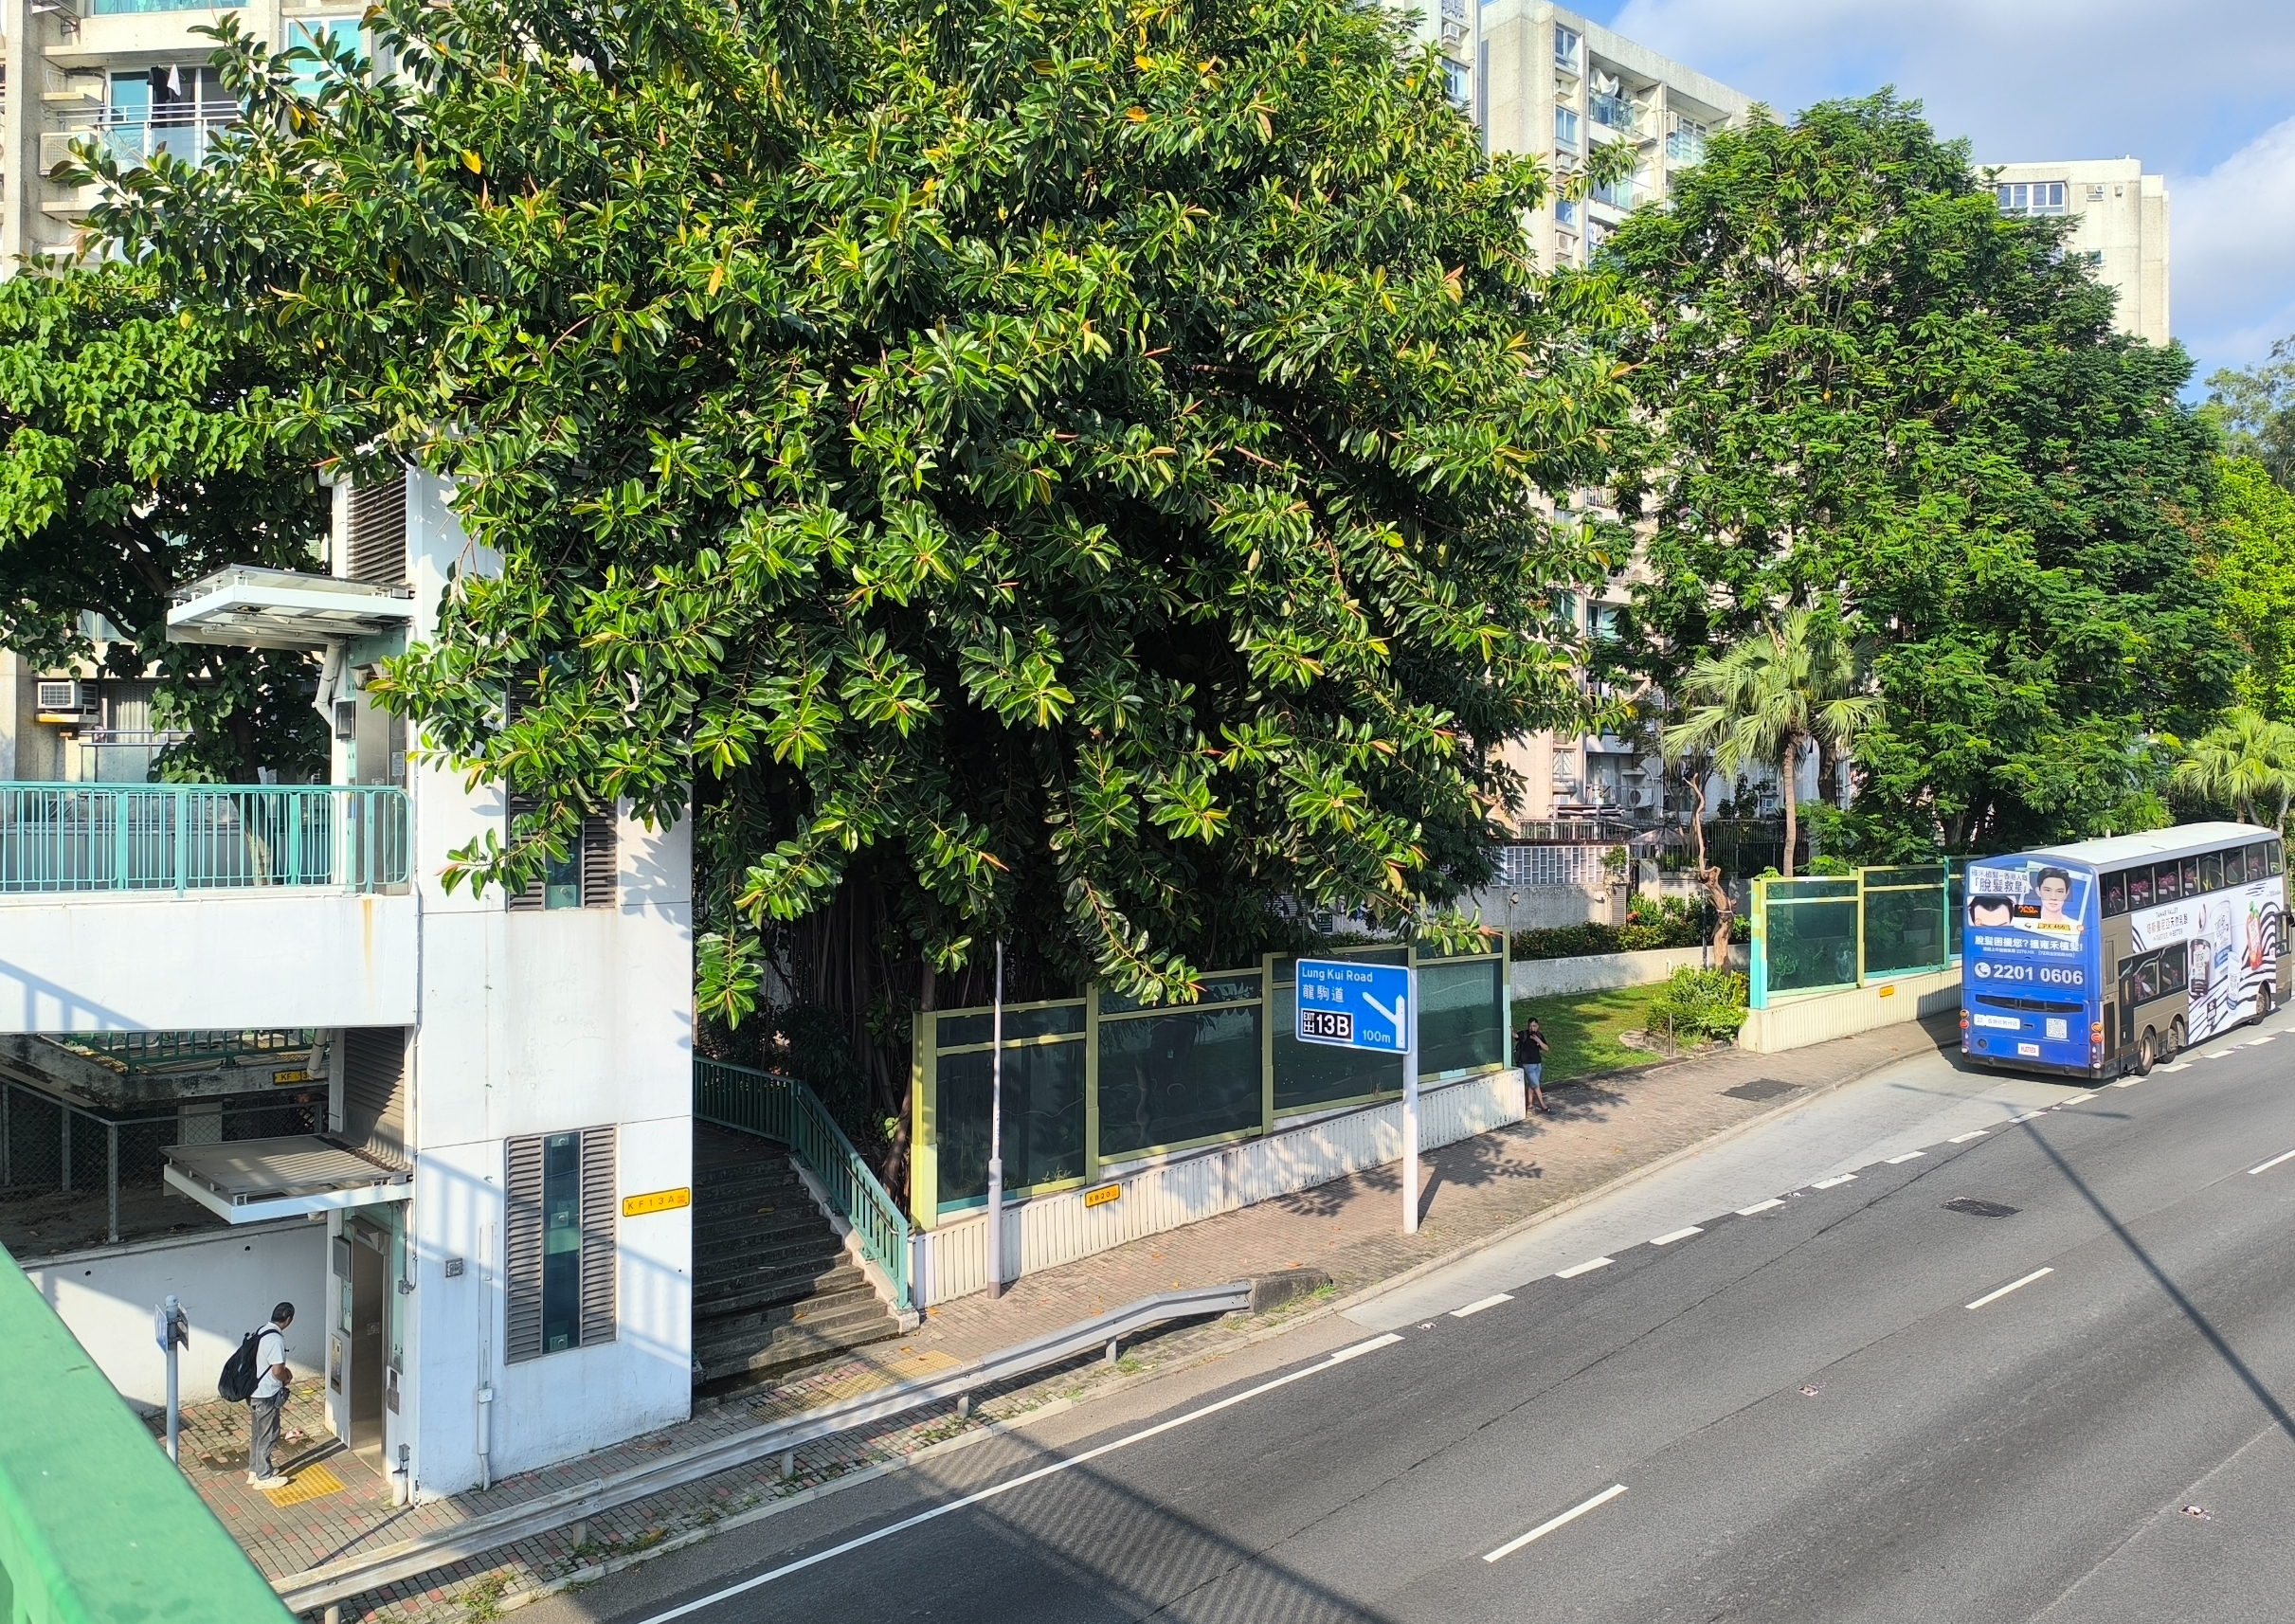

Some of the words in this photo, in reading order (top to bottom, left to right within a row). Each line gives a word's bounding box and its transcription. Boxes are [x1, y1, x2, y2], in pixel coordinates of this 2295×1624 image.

[1302, 966, 1326, 981] Lung
[1328, 968, 1344, 981] Kui
[1346, 970, 1373, 983] Road
[1994, 964, 2033, 981] 2201
[2040, 967, 2084, 985] 0606
[1302, 983, 1344, 1002] 龍駒道
[1303, 1012, 1315, 1021] EXIT
[1303, 1021, 1315, 1034] 出
[1316, 1014, 1349, 1037] 13B
[1363, 1029, 1391, 1043] 100m
[280, 1073, 292, 1081] KF
